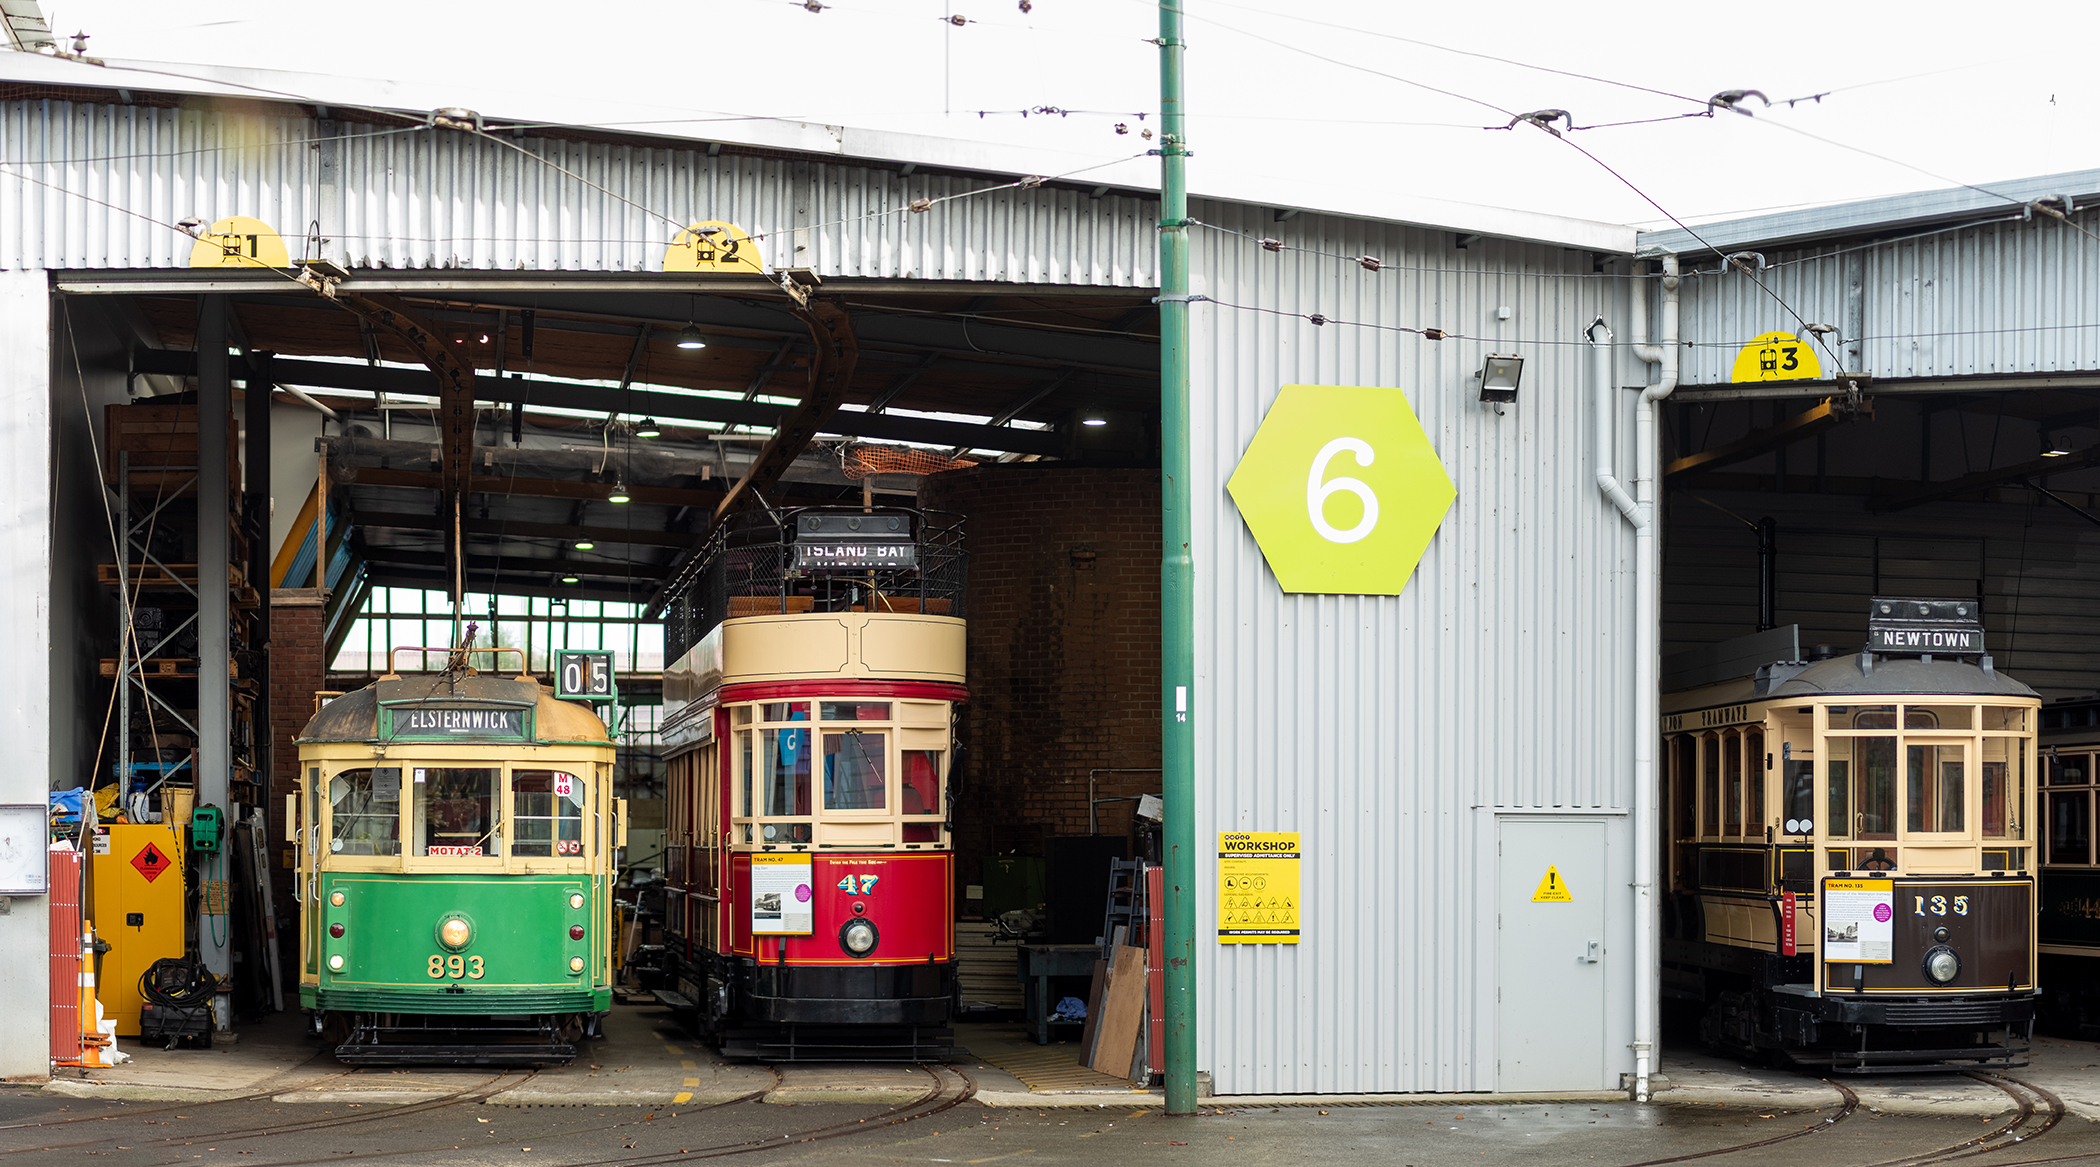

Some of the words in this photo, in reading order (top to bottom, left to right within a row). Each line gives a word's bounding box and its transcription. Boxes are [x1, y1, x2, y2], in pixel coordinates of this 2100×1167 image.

[246, 234, 257, 258] 1
[720, 239, 739, 263] 2
[1781, 347, 1799, 371] 3
[1306, 436, 1379, 544] 6
[1884, 631, 1970, 647] NEWTOWN
[411, 710, 509, 729] ELSTERNWICK
[1176, 713, 1186, 722] 14
[1702, 705, 1747, 726] TRAMWAYS
[558, 774, 568, 783] M
[556, 785, 571, 795] 48
[1225, 841, 1295, 851] WORKSHOP
[837, 874, 879, 895] 47
[1915, 895, 1969, 916] 135
[427, 954, 485, 979] 893
